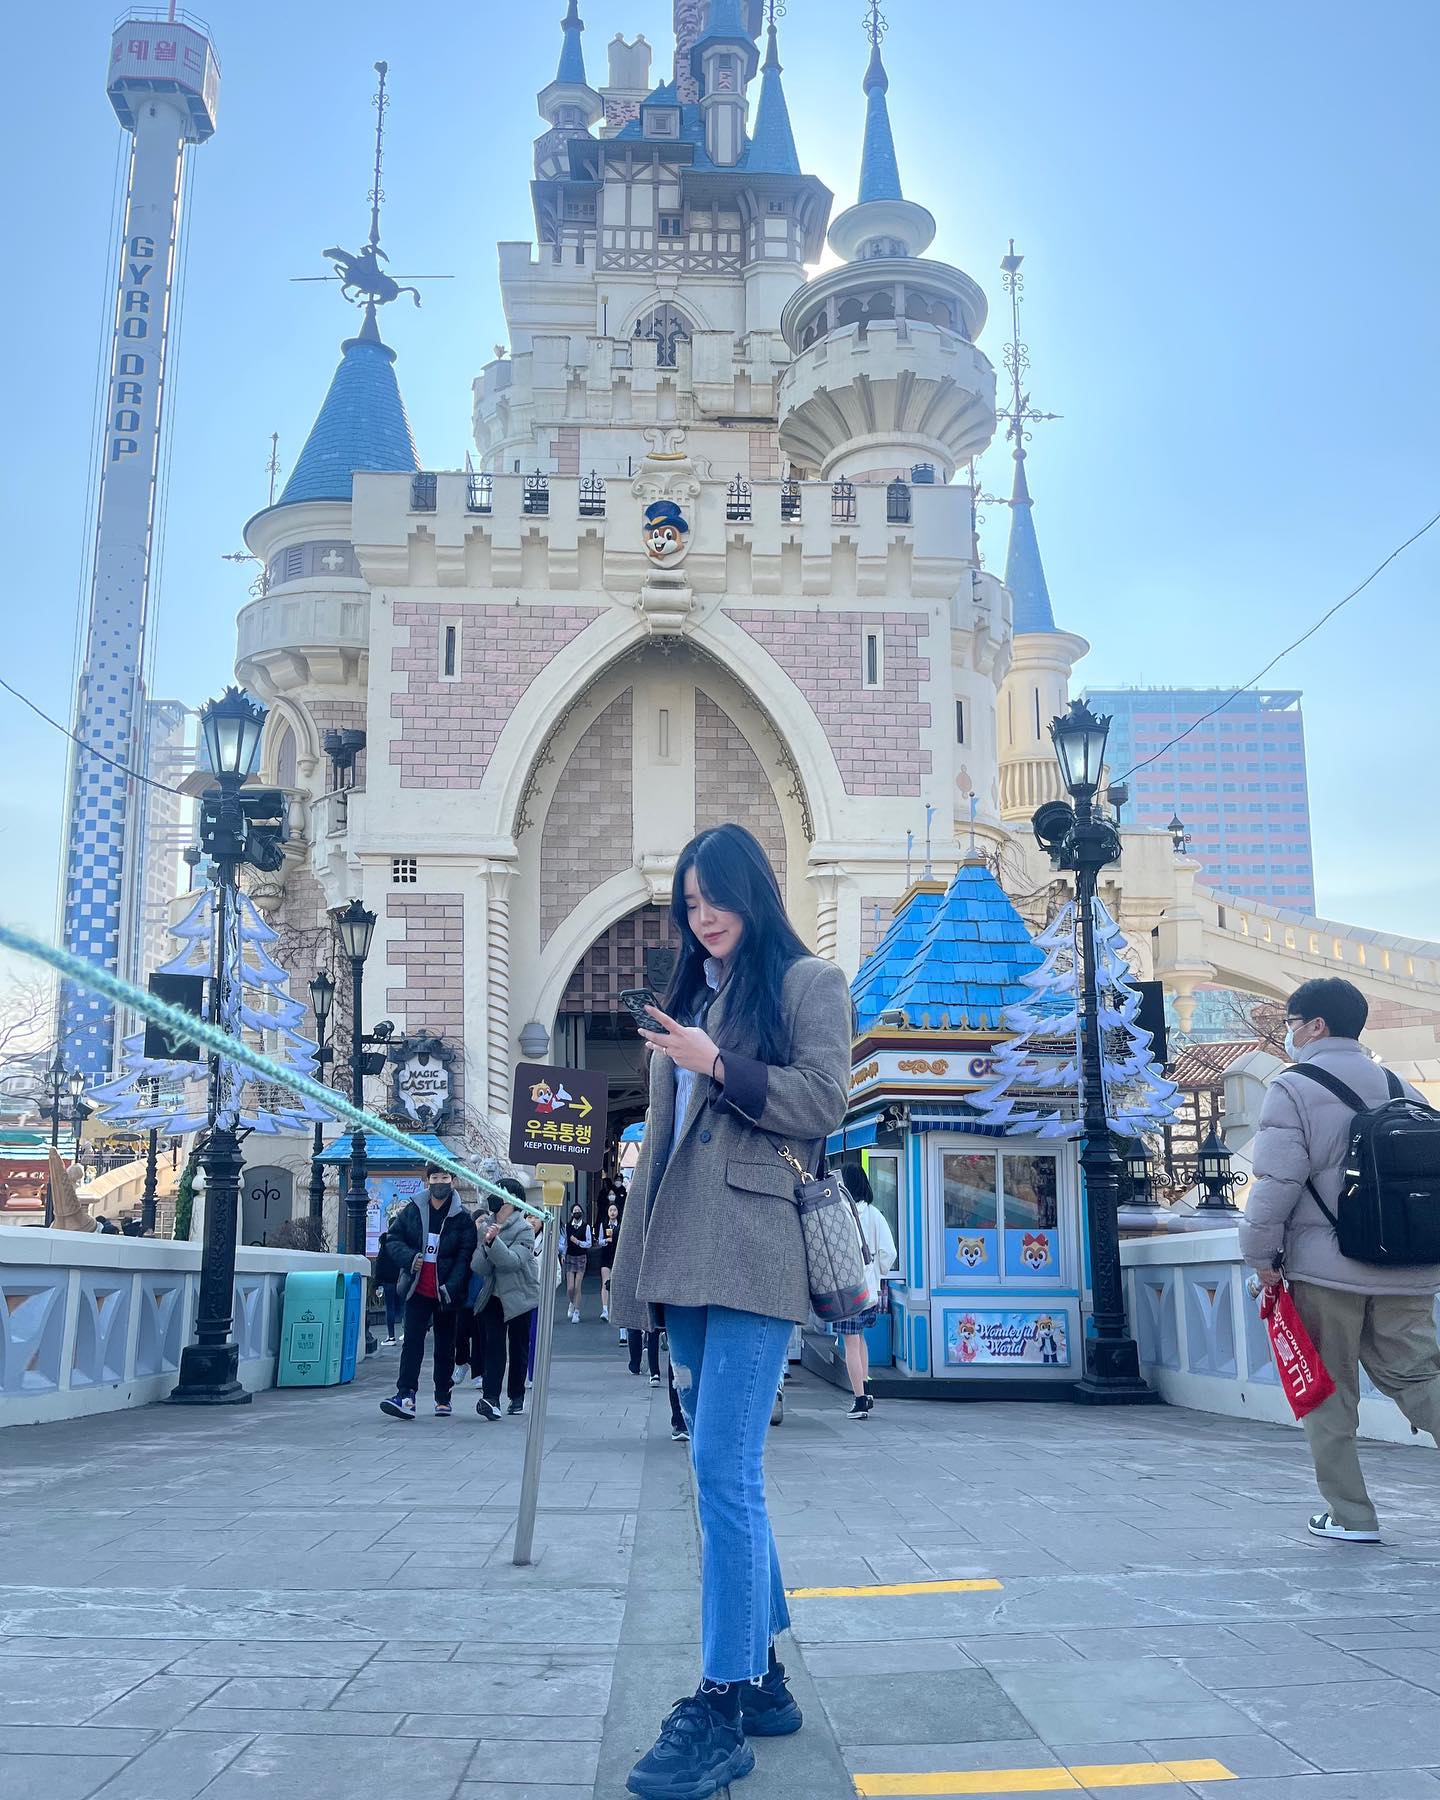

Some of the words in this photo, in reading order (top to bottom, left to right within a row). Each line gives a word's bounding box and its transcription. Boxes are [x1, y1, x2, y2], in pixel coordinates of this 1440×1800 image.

[123, 236, 154, 339] GYRO
[112, 353, 145, 461] DROP
[409, 1070, 439, 1079] MAGIC
[401, 1079, 447, 1090] CASTLE
[525, 1119, 592, 1144] 우측통행
[523, 1140, 542, 1150] KEEP
[543, 1142, 552, 1151] TO
[553, 1143, 567, 1152] THE
[568, 1145, 591, 1154] RIGHT
[976, 1323, 1038, 1342] Wonderful
[986, 1338, 1027, 1357] World
